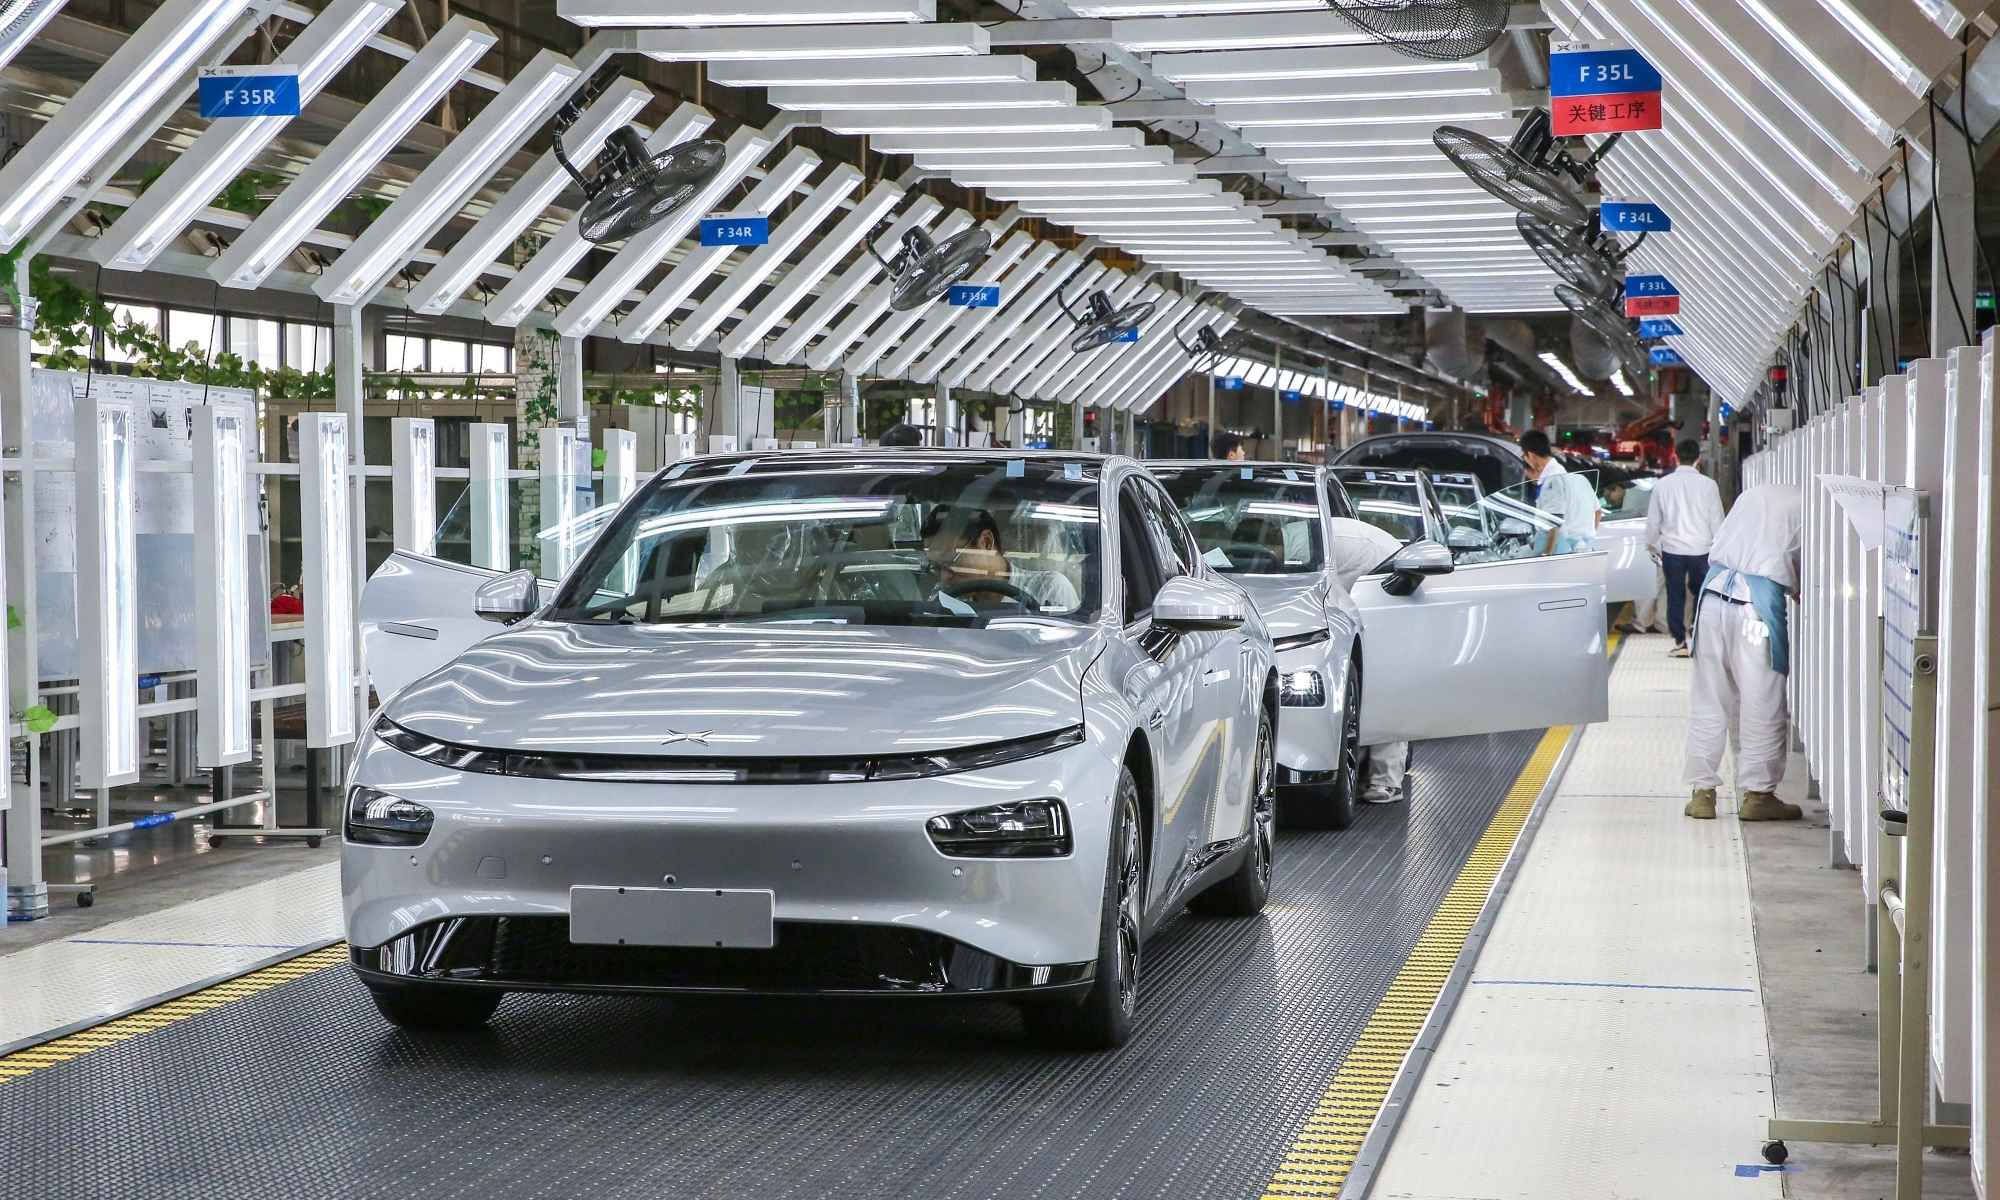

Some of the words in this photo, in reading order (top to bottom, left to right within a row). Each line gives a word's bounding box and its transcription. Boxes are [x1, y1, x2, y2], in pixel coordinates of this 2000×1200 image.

[1580, 65, 1590, 83] F
[1597, 63, 1634, 81] 35L
[224, 90, 234, 105] F
[240, 89, 276, 105] 35R
[1568, 101, 1646, 124] 关键工序
[1619, 212, 1626, 223] F
[1630, 212, 1654, 223] 34L
[717, 227, 724, 238] F
[728, 226, 752, 238] 34R
[1640, 282, 1645, 291] F
[1648, 281, 1667, 290] 33L
[961, 291, 967, 300] F
[1651, 324, 1657, 333] F
